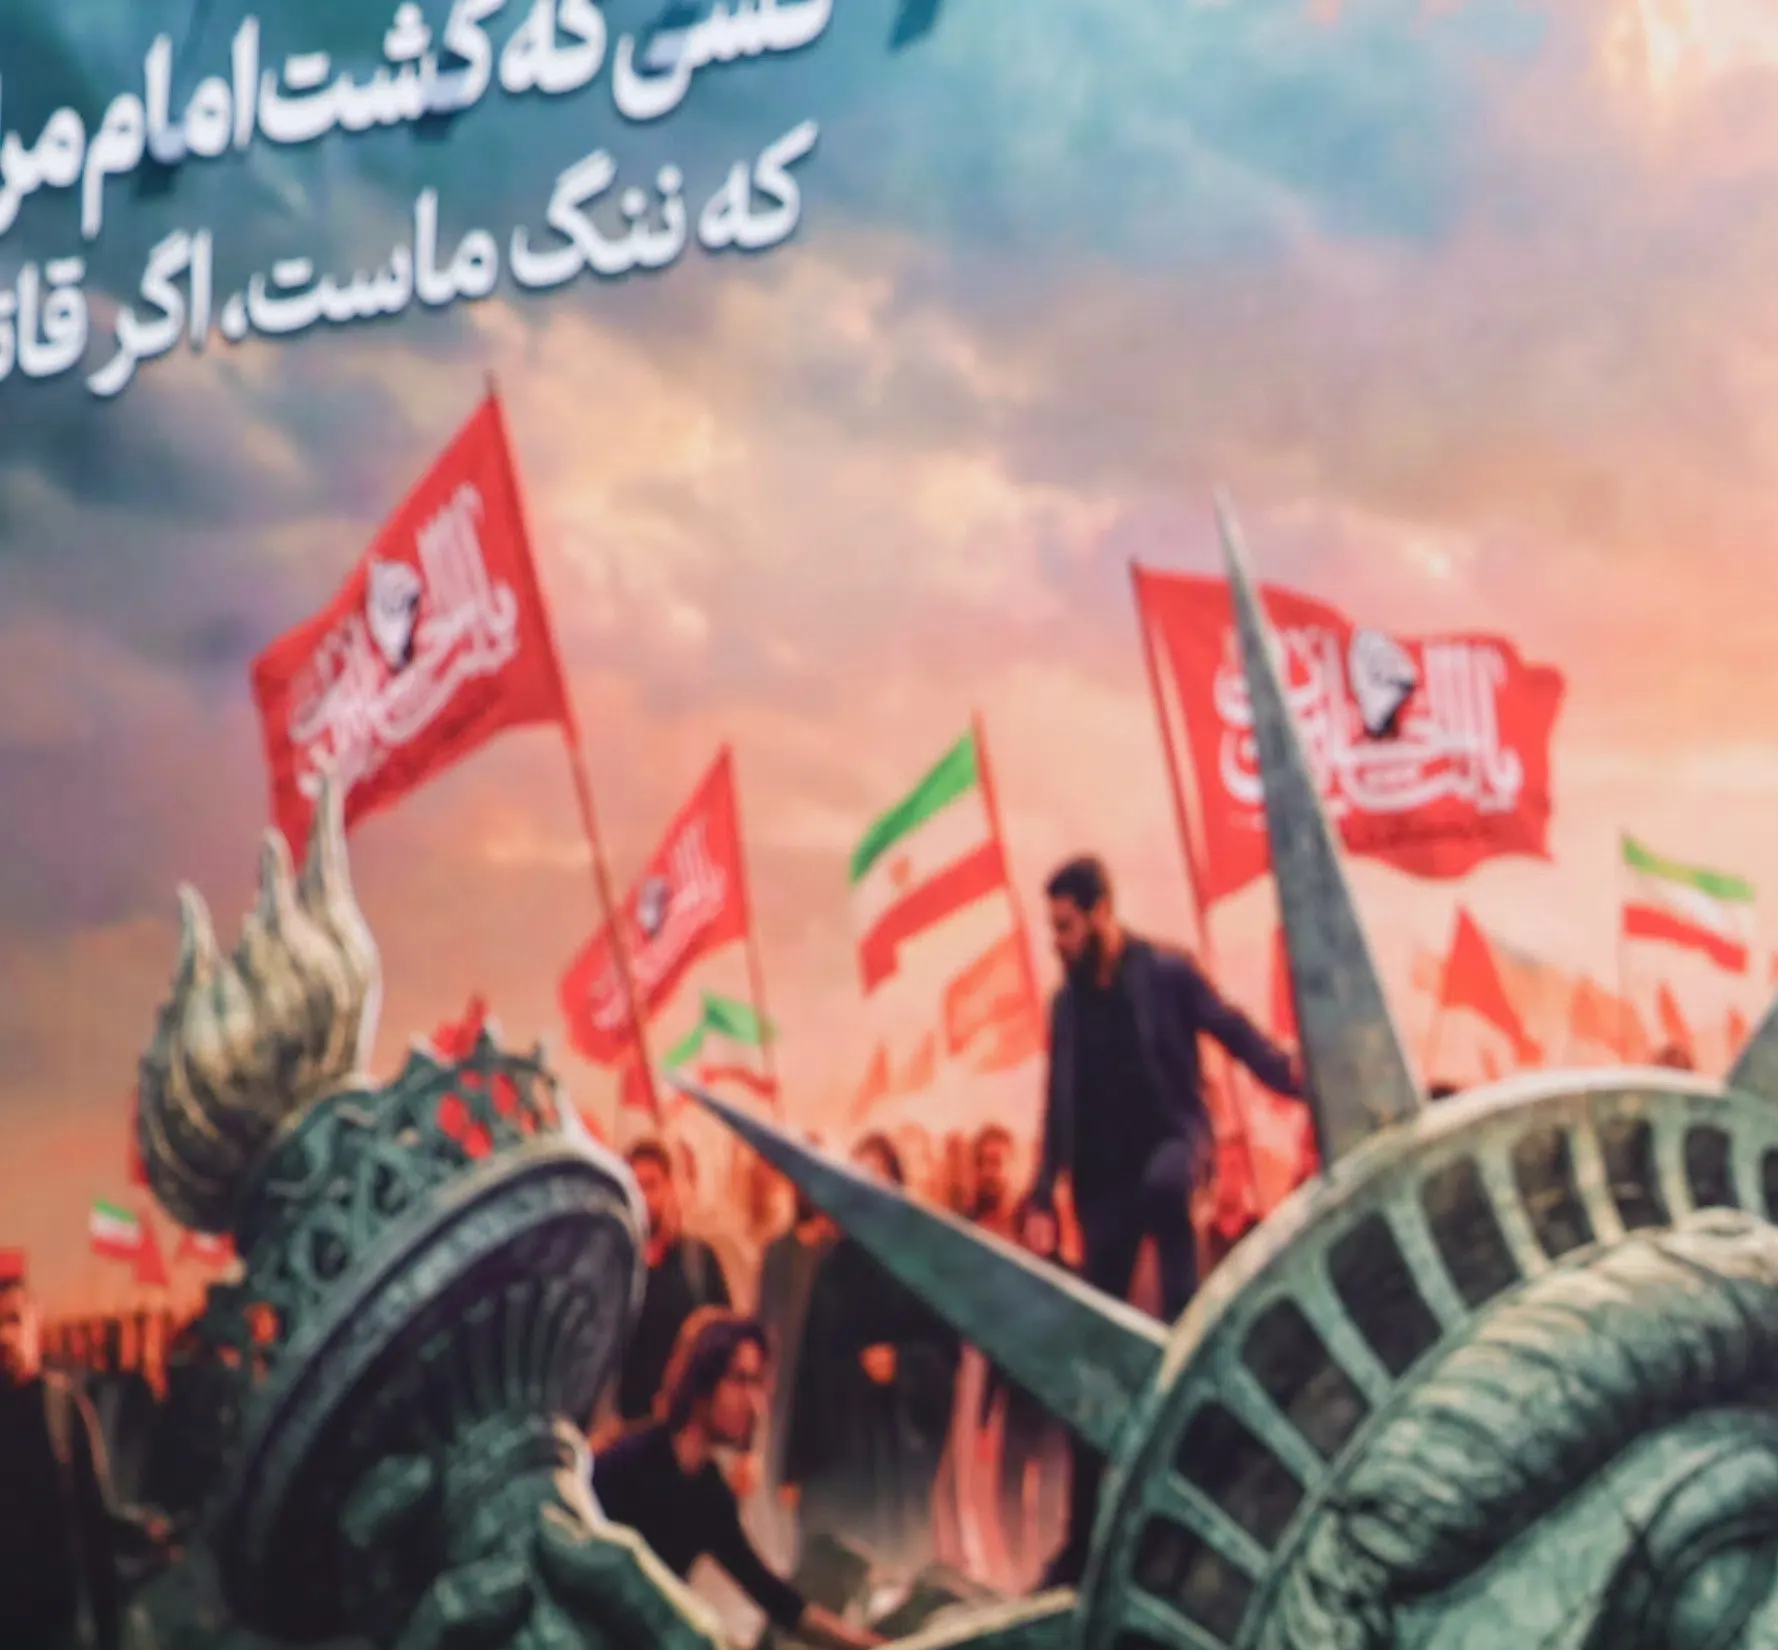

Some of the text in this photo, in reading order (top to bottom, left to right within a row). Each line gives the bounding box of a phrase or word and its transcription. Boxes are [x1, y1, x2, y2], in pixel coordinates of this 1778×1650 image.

[259, 0, 508, 143] کشت
[500, 0, 607, 94] که
[0, 70, 86, 236] مر
[81, 15, 260, 240] امام
[699, 119, 820, 249] که
[510, 148, 688, 287] ننگ
[87, 228, 212, 396] اگر
